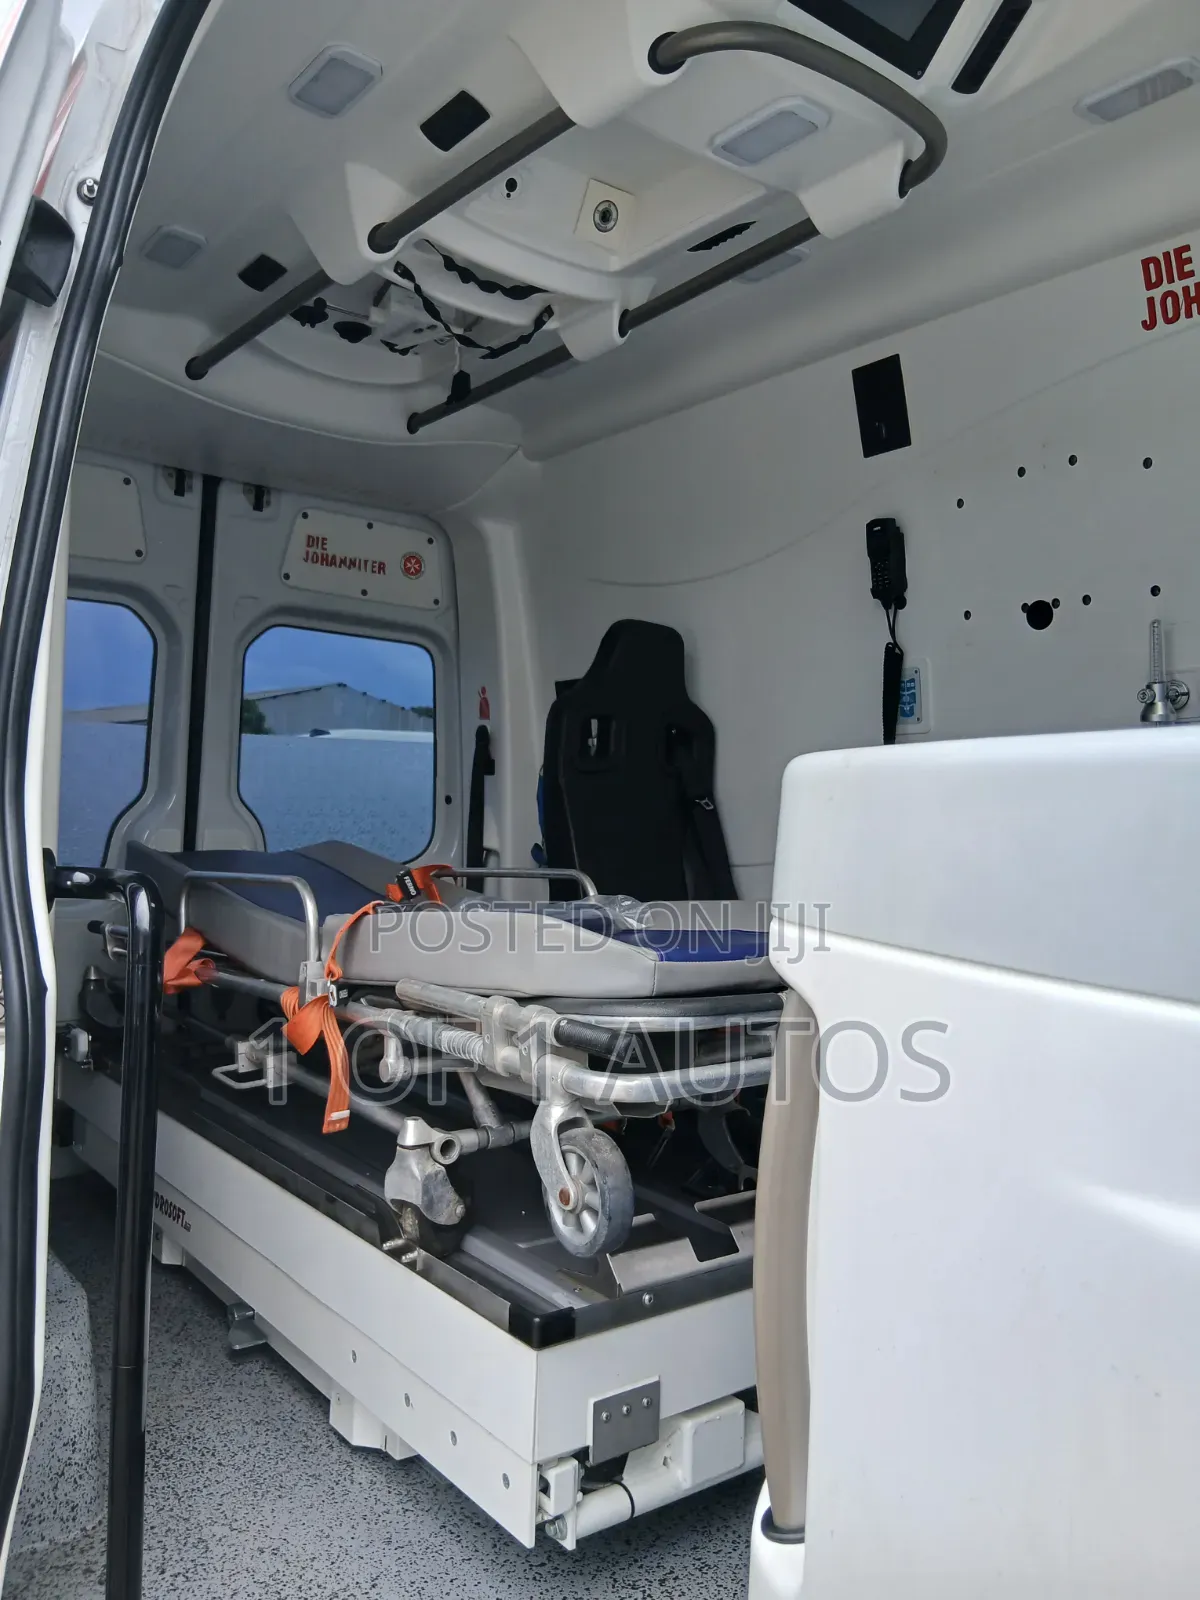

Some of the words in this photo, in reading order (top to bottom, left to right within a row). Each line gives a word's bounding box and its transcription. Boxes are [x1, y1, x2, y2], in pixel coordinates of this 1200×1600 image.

[1140, 244, 1196, 292] DIE
[306, 534, 328, 551] DIE
[303, 549, 386, 575] JOHANNITER
[154, 1191, 186, 1227] DROSOFT
